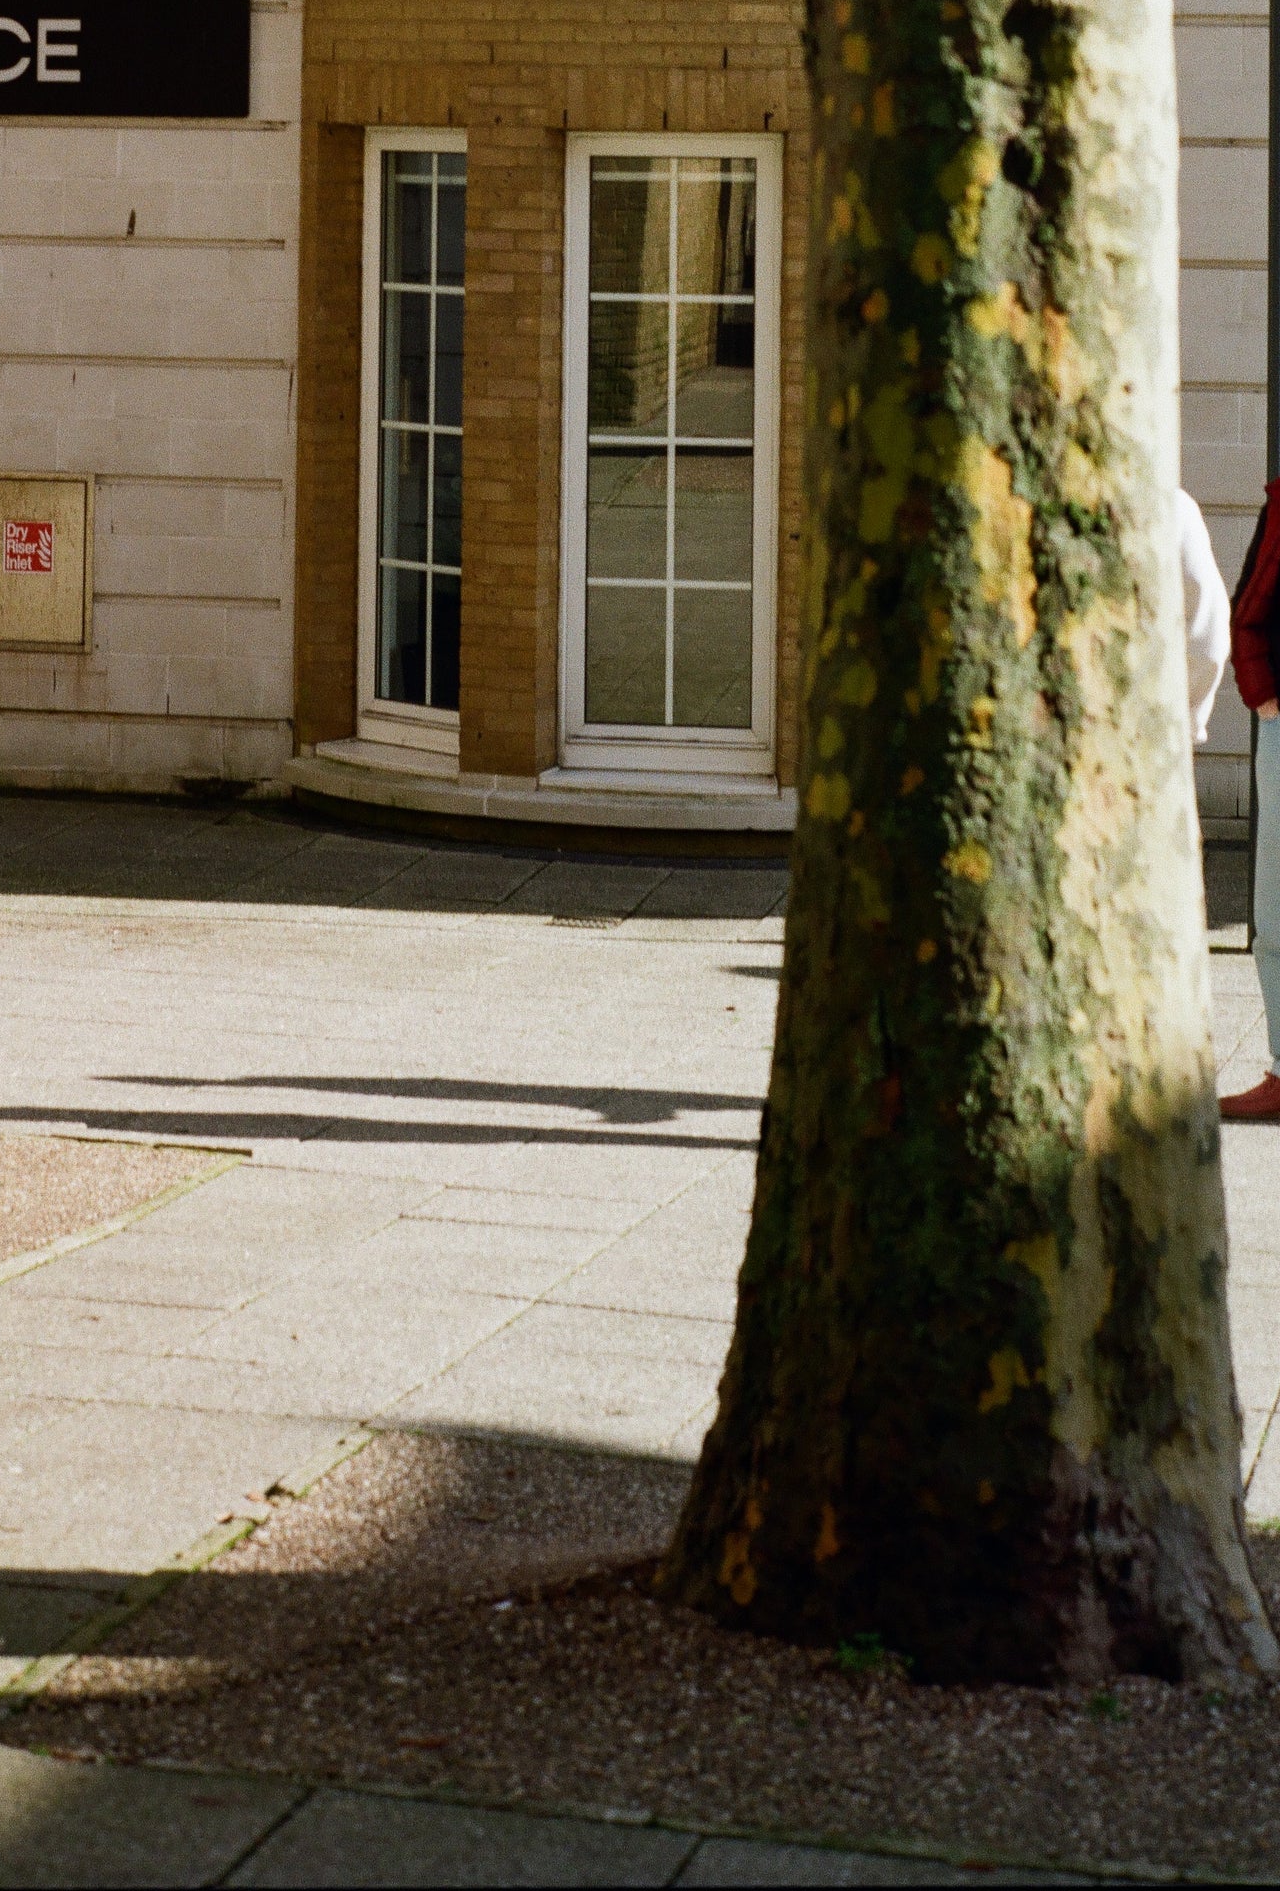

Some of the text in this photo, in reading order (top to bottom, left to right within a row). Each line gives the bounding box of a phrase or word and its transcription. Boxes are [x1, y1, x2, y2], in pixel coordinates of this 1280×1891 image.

[7, 523, 28, 541] Dry
[7, 539, 37, 554] Riser
[7, 554, 32, 569] Inlet
